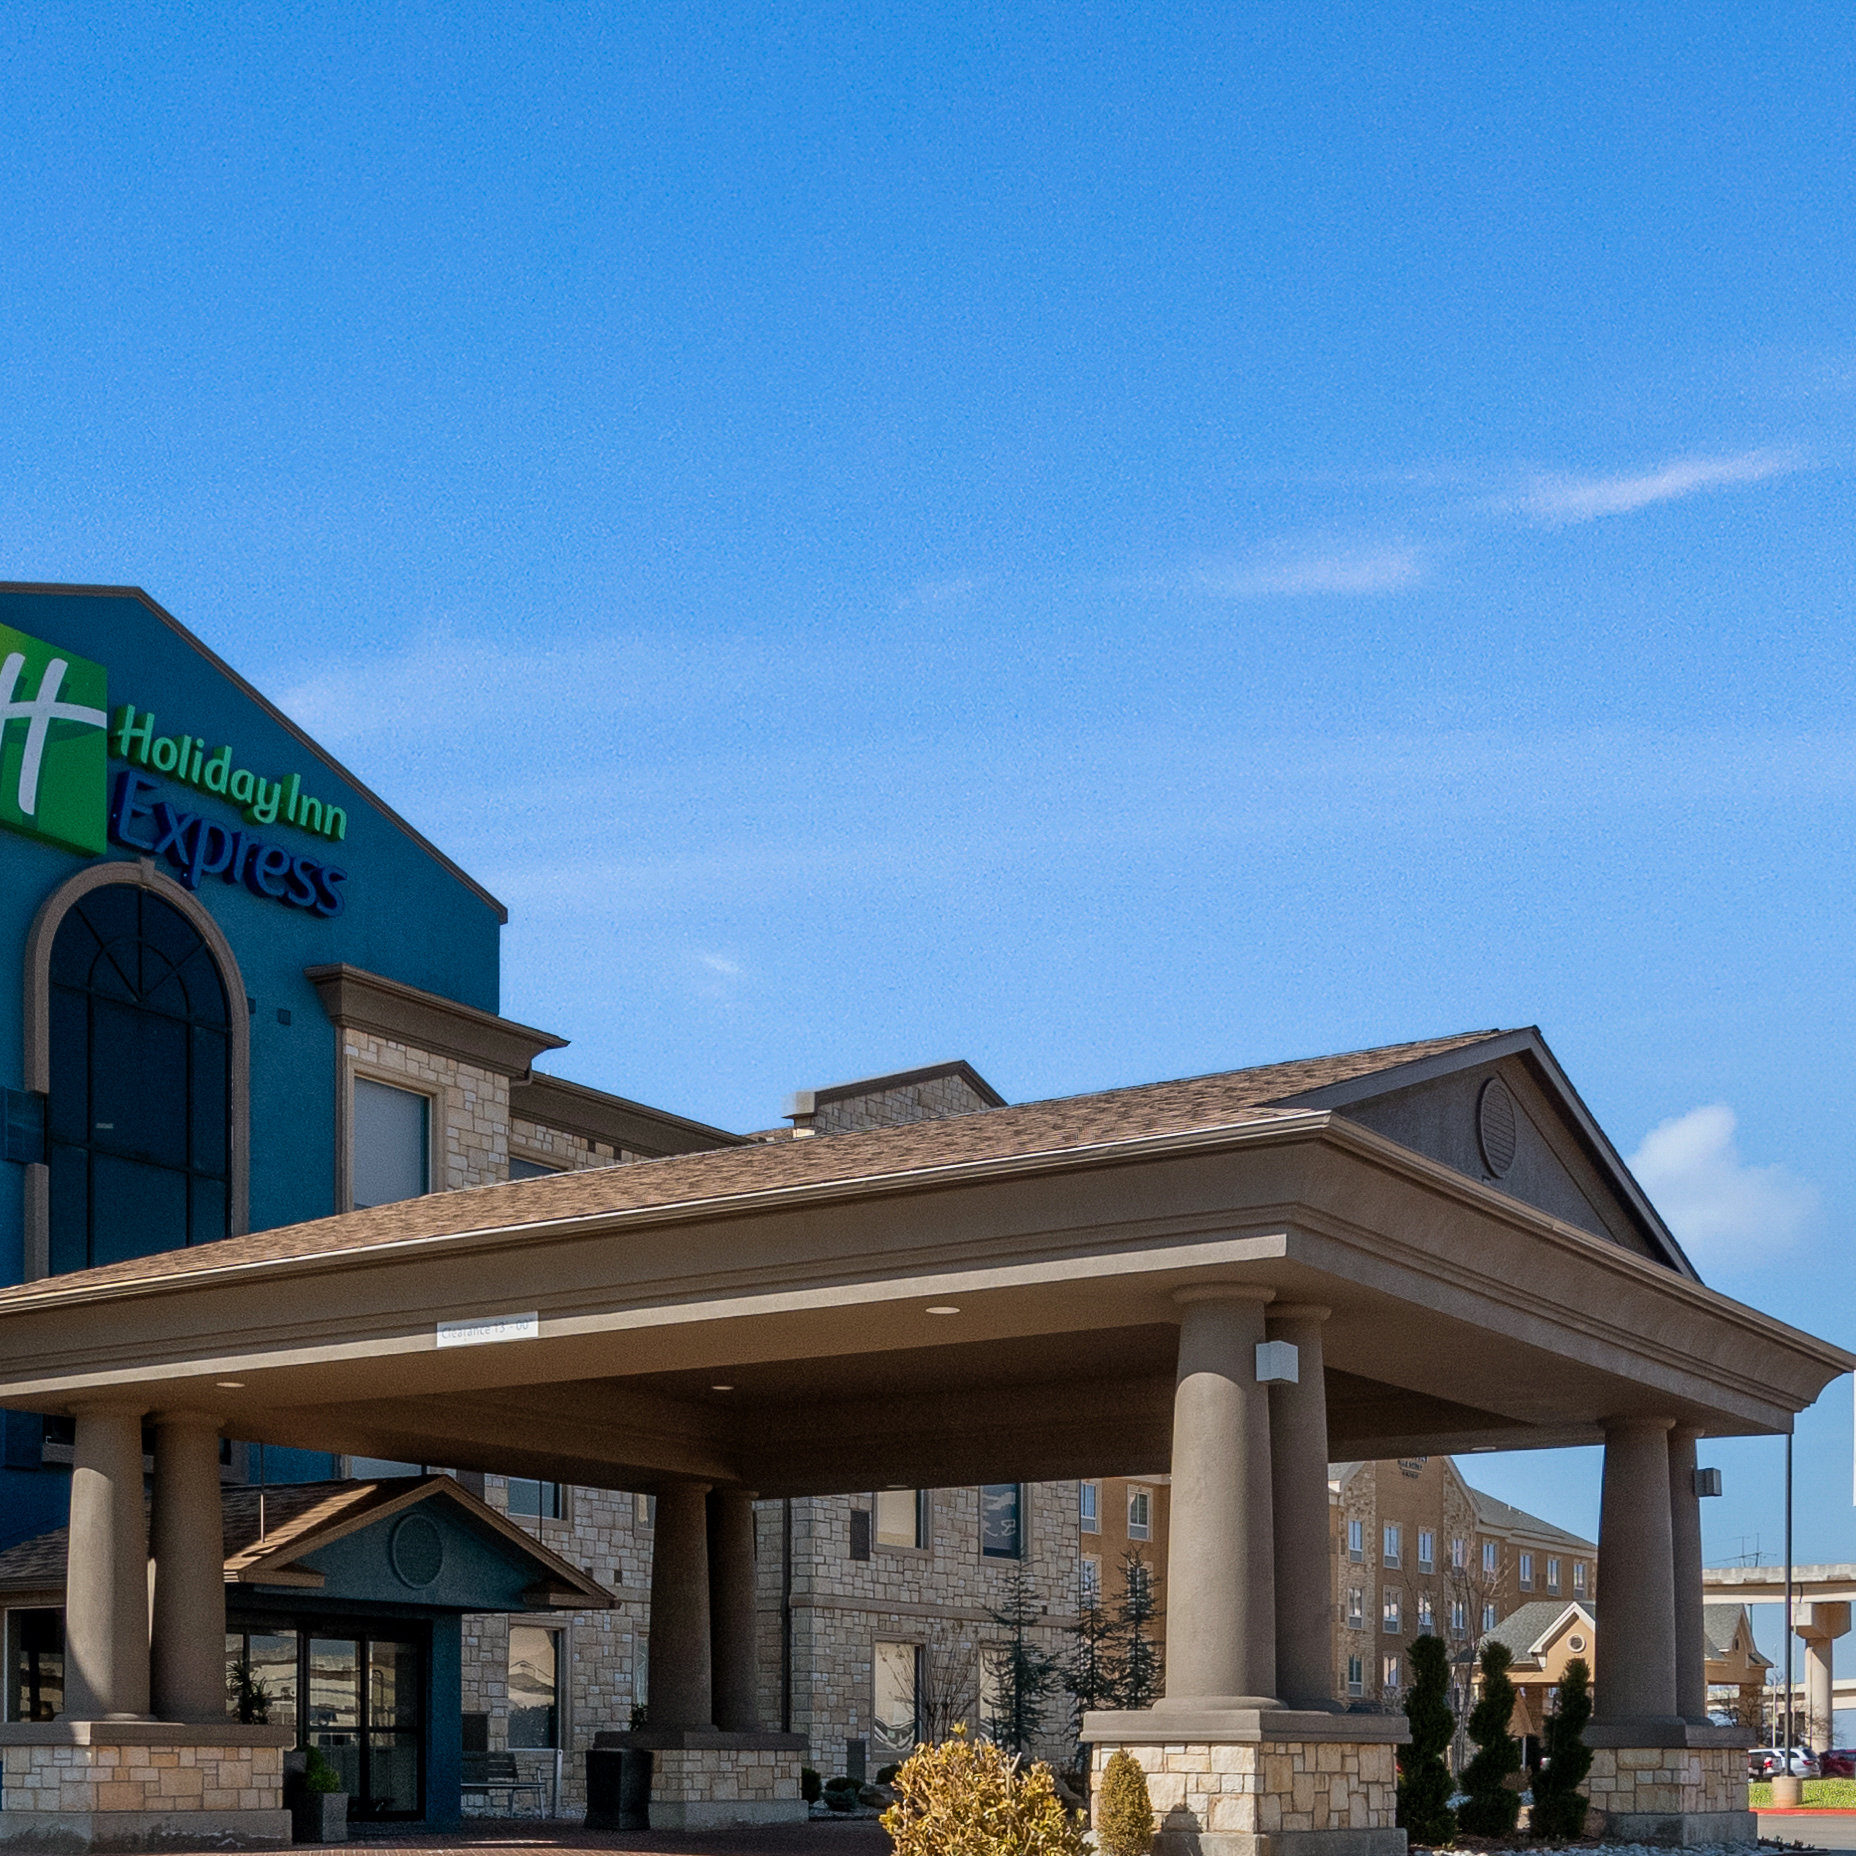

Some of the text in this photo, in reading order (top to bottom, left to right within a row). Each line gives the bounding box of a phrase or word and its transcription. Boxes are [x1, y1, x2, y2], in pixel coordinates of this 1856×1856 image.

[111, 703, 348, 841] Holiday Inn
[109, 770, 348, 918] Express
[441, 1326, 490, 1339] Clearance
